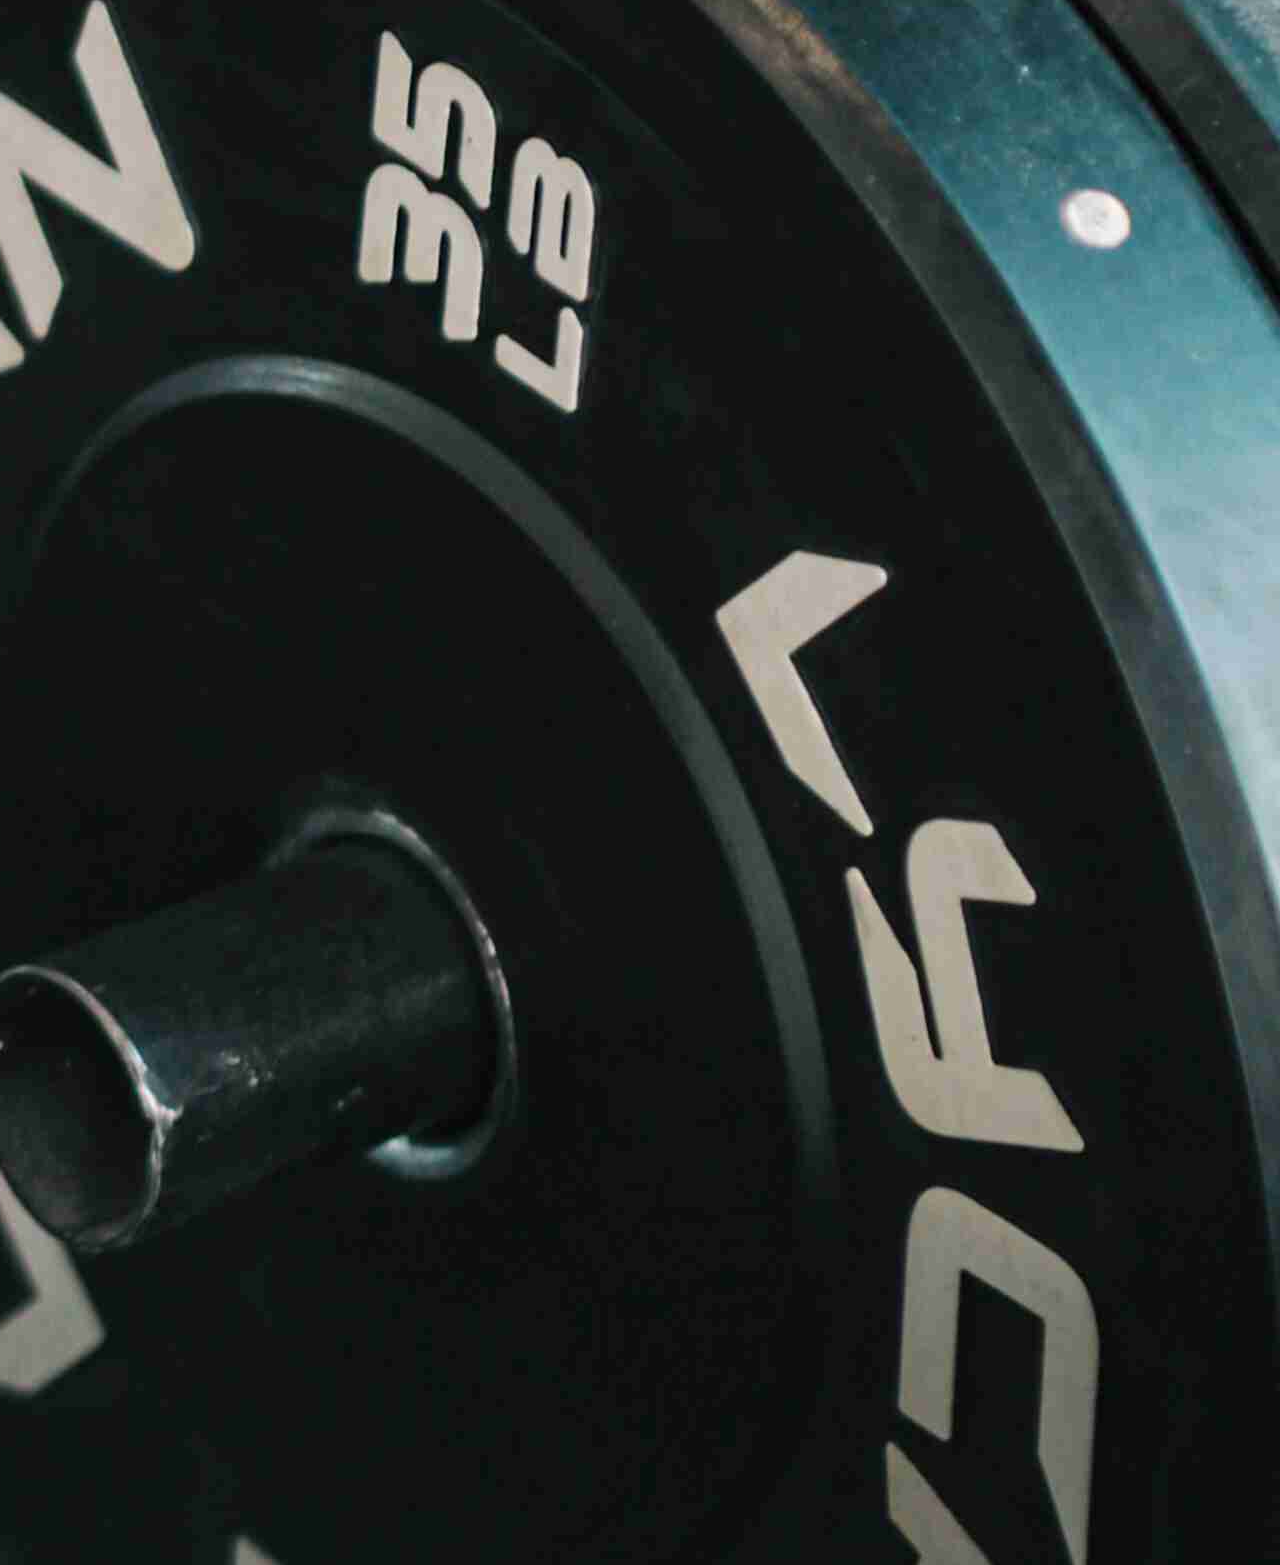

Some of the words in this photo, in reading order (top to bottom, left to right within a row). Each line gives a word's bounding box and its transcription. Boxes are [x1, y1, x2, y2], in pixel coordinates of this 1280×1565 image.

[357, 27, 497, 343] 35
[493, 134, 596, 416] LB
[716, 549, 1102, 1565] LYC
